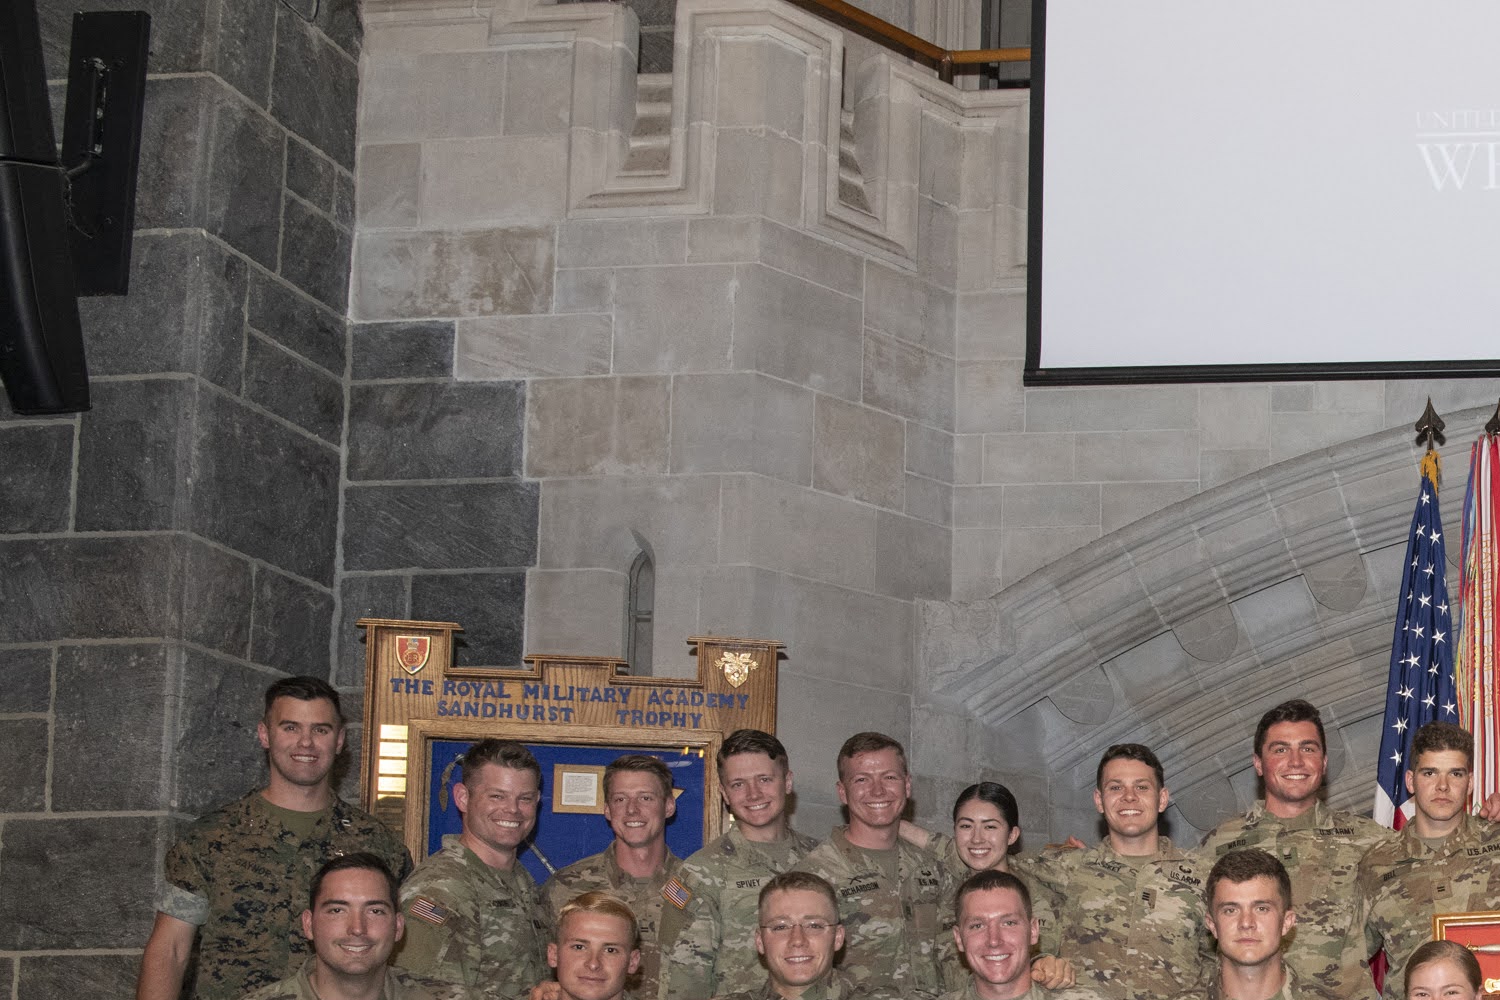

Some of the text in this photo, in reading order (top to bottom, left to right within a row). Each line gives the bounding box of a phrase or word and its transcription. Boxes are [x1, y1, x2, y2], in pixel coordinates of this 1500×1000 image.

[390, 678, 750, 710] THE ROYAL MILITARY ACADEMY
[437, 700, 703, 729] SANDHURST TROPHY
[1228, 839, 1246, 849] WARD
[1383, 870, 1396, 881] BELL
[735, 878, 760, 888] SPIVEY
[840, 882, 880, 897] RICHARDSON
